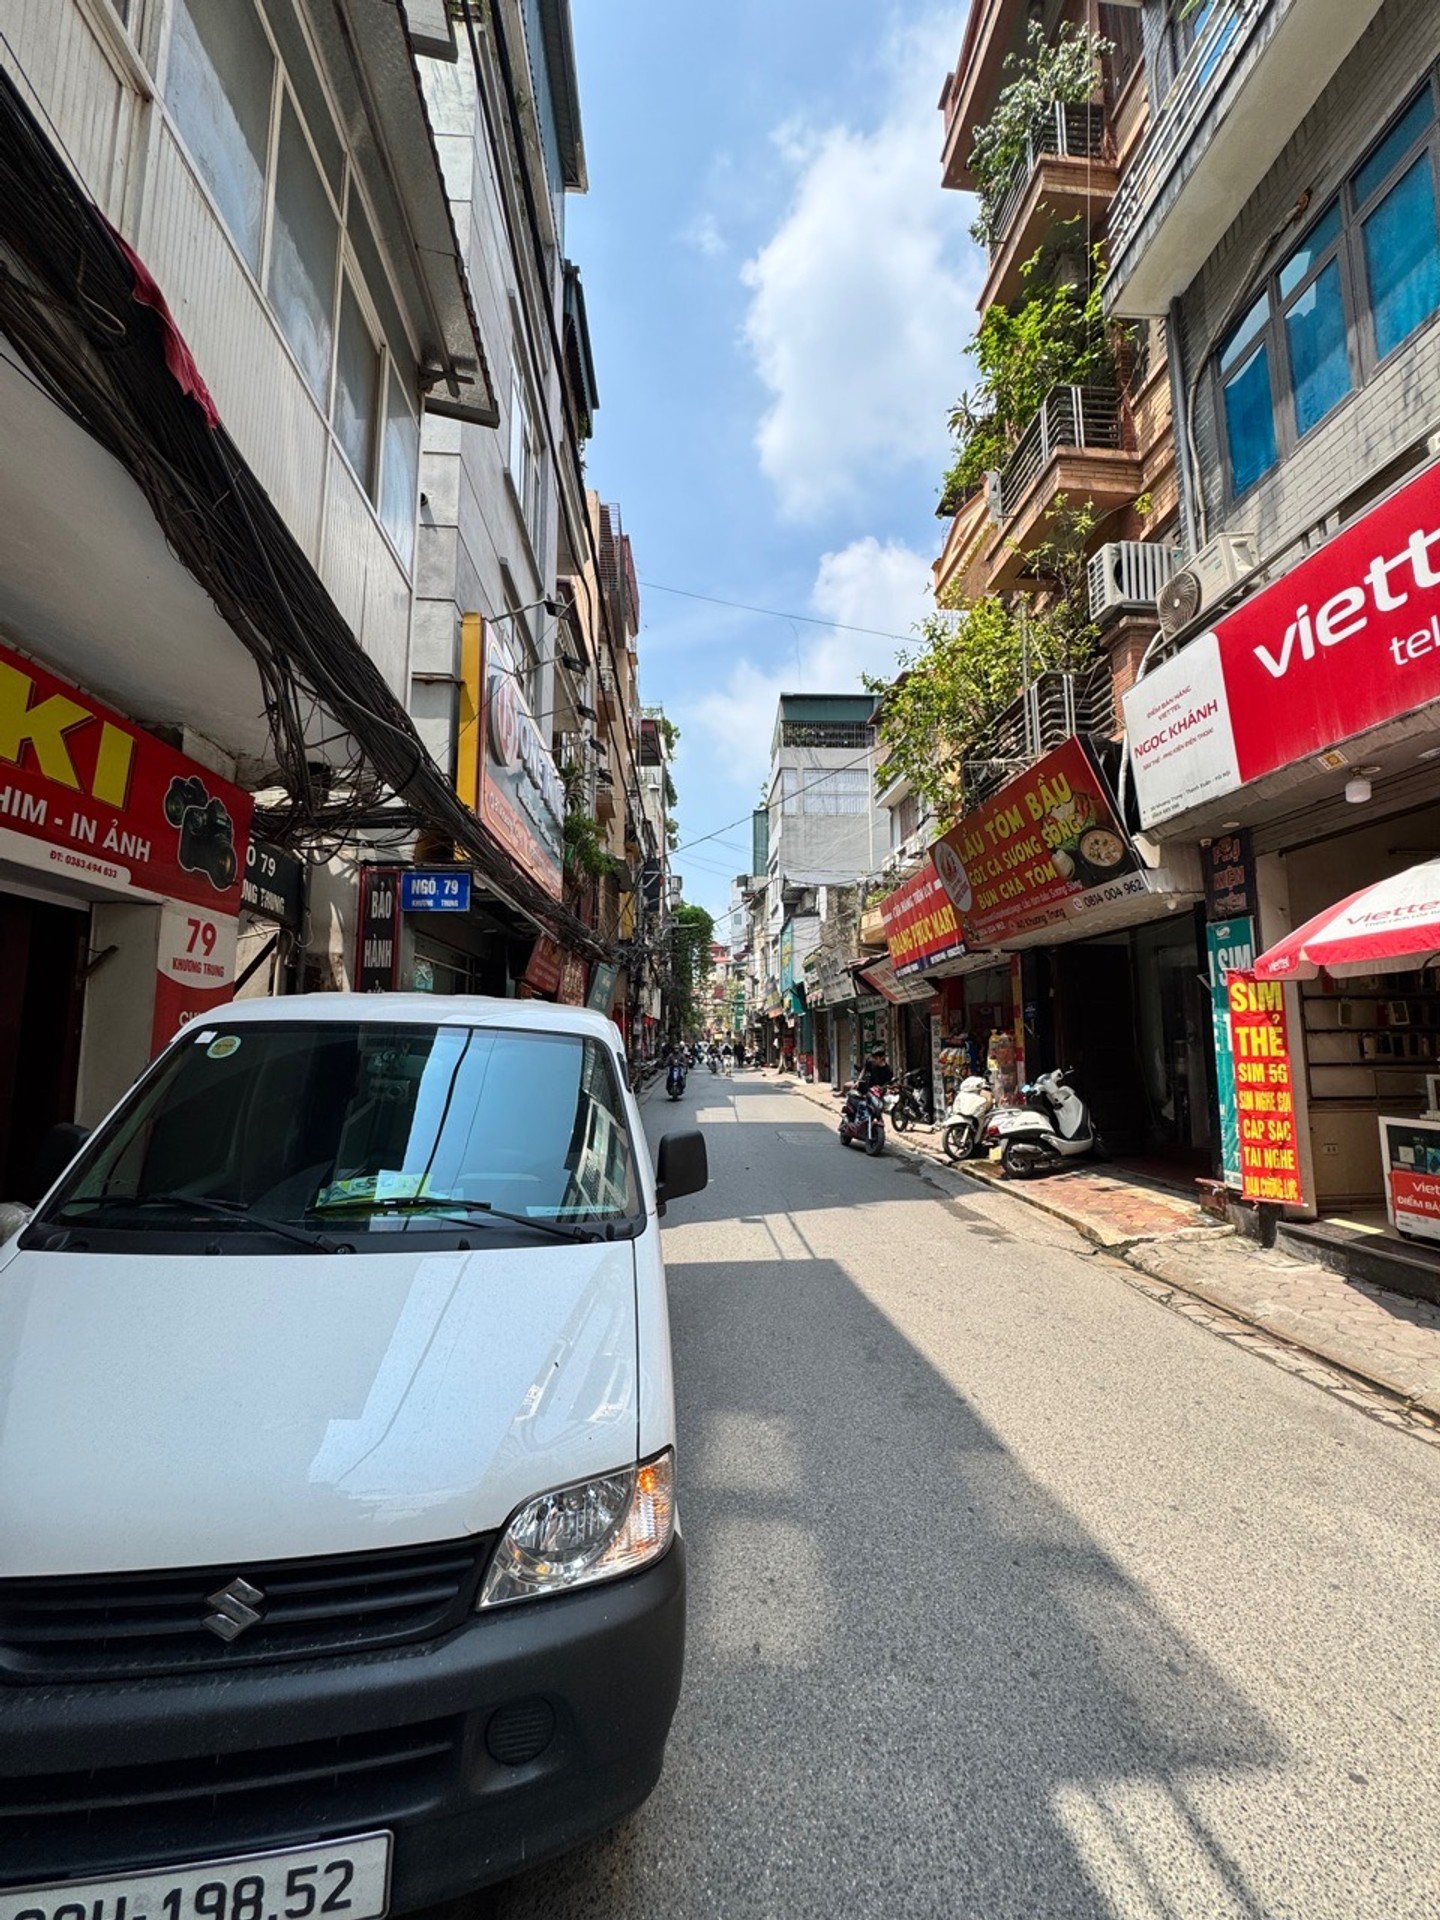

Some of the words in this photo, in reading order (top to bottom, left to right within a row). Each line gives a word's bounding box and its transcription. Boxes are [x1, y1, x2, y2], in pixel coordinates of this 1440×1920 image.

[1174, 685, 1193, 701] HÀNG
[1157, 703, 1182, 721] VIETTEL
[1133, 730, 1168, 760] NGỌC
[1167, 698, 1219, 740] KHÁNH
[955, 828, 985, 865] LẨU
[984, 804, 1026, 845] TÔM
[1024, 772, 1073, 821] BẦU
[1041, 814, 1081, 849] SÔNG
[70, 812, 97, 844] IN
[102, 818, 151, 863] ẢNH
[260, 852, 276, 877] 79
[371, 880, 393, 919] BẢO
[443, 880, 459, 895] 79
[976, 888, 1000, 911] BÚN
[1000, 871, 1026, 900] CHẢ
[1025, 861, 1058, 888] TÔM
[1103, 886, 1123, 901] 004
[1123, 878, 1145, 895] 962
[930, 903, 958, 938] MART
[1046, 907, 1067, 920] Trung
[186, 917, 217, 957] 79
[203, 962, 225, 978] TRUNG
[1230, 981, 1283, 1012] SIM
[1234, 1013, 1286, 1057] THẺ
[1237, 1061, 1265, 1083] SIM
[1268, 1063, 1289, 1083] 5G
[1239, 1090, 1254, 1110] SIM
[1243, 1114, 1265, 1140] CÁP
[1267, 1119, 1292, 1145] SẠC
[1243, 1145, 1262, 1168] TAI
[1263, 1147, 1296, 1170] NGHE
